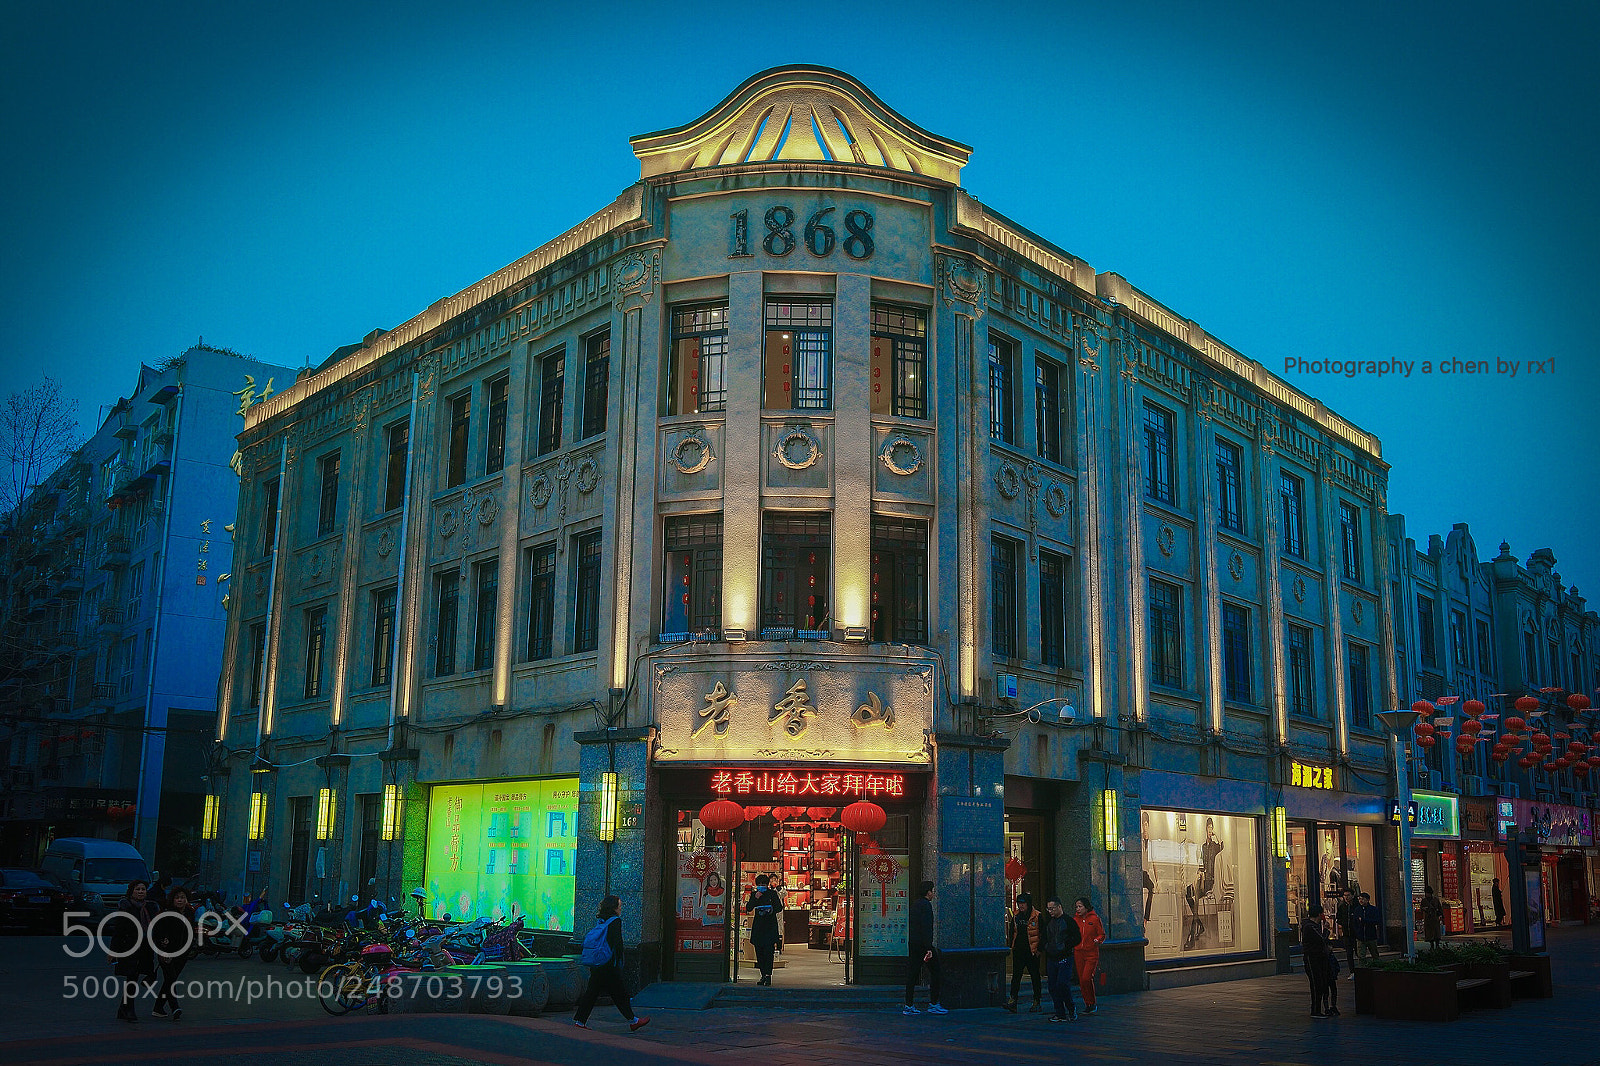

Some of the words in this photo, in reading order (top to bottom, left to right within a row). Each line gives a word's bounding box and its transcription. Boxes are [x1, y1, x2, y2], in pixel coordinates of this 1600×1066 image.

[726, 205, 875, 260] 1868
[691, 678, 896, 742] 老香山
[711, 771, 904, 796] 老香山给大家拜年啦
[622, 816, 638, 827] 168
[1393, 805, 1415, 815] HA
